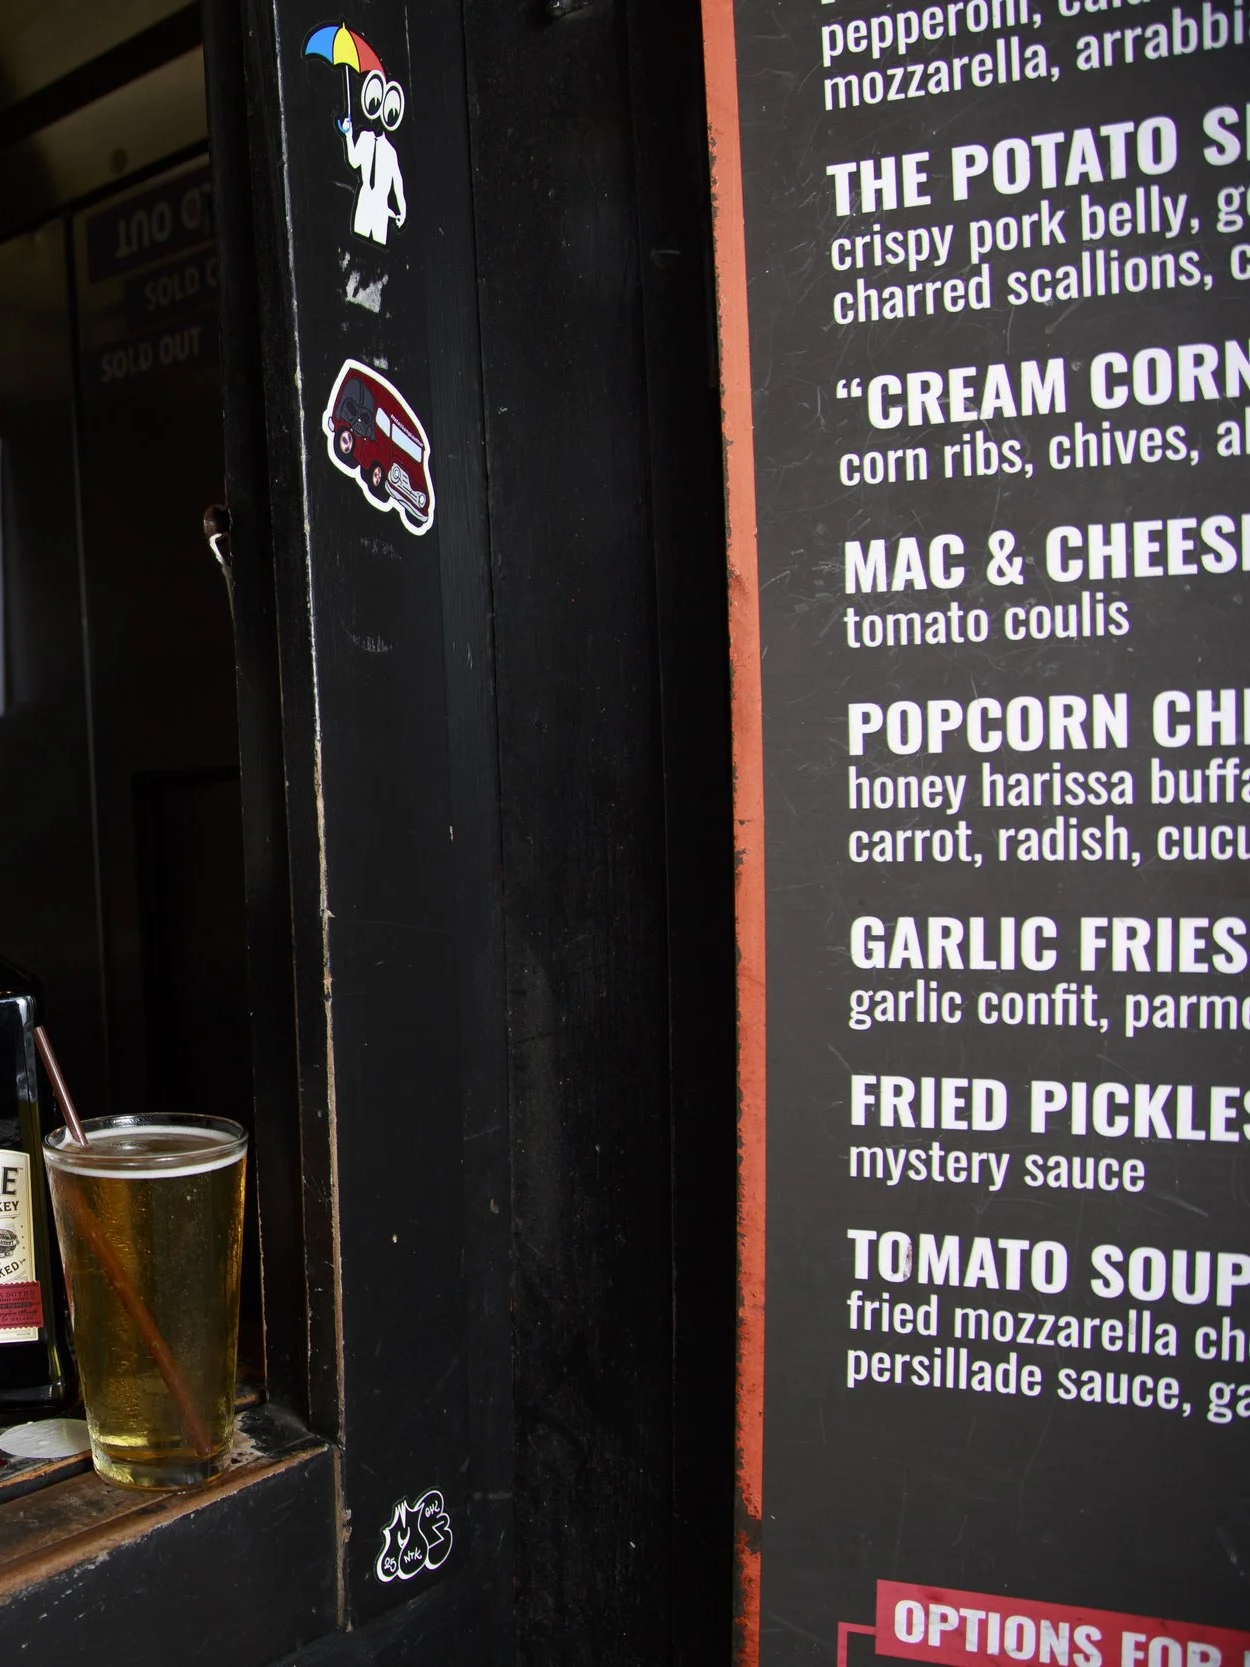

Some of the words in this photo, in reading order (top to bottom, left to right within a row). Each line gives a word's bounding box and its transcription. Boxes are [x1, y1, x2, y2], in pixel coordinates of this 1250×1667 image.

[823, 36, 1060, 111] mozzarella,
[1075, 1, 1250, 71] arrabbi
[825, 151, 932, 217] THE
[951, 116, 1178, 202] POTATO
[1202, 103, 1250, 166] S
[831, 223, 954, 272] crispy
[969, 199, 1067, 265] pork
[1080, 184, 1200, 241] belly,
[1216, 185, 1250, 233] g
[833, 262, 991, 325] charred
[1007, 248, 1213, 306] scallions,
[1090, 339, 1250, 410] CORN
[839, 447, 928, 487] corn
[943, 429, 1034, 479] ribs,
[1048, 420, 1199, 470] chives,
[844, 533, 965, 595] MAC
[986, 529, 1024, 587] &
[842, 601, 989, 649] tomato
[1004, 590, 1130, 641] coulis
[847, 692, 1128, 756] POPCORN
[848, 765, 967, 816] honey
[981, 761, 1134, 807] harissa
[848, 820, 983, 869] carrot,
[998, 814, 1141, 868] radish,
[1157, 824, 1250, 861] cucu
[850, 915, 1058, 972] GARLIC
[1080, 916, 1248, 975] FRIES
[848, 978, 962, 1031] garlic
[977, 982, 1109, 1034] confit,
[850, 1074, 1008, 1132] FRIED
[849, 1141, 1010, 1192] mystery
[1023, 1153, 1145, 1193] sauce
[846, 1228, 1068, 1295] TOMATO
[1090, 1244, 1250, 1307] SOUP
[846, 1289, 938, 1337] fried
[954, 1307, 1177, 1357] mozzarella
[1194, 1316, 1250, 1363] ch
[846, 1346, 1042, 1397] persillade
[1057, 1368, 1191, 1418] sauce,
[1207, 1381, 1250, 1424] ga
[893, 1599, 1103, 1667] OPTIONS
